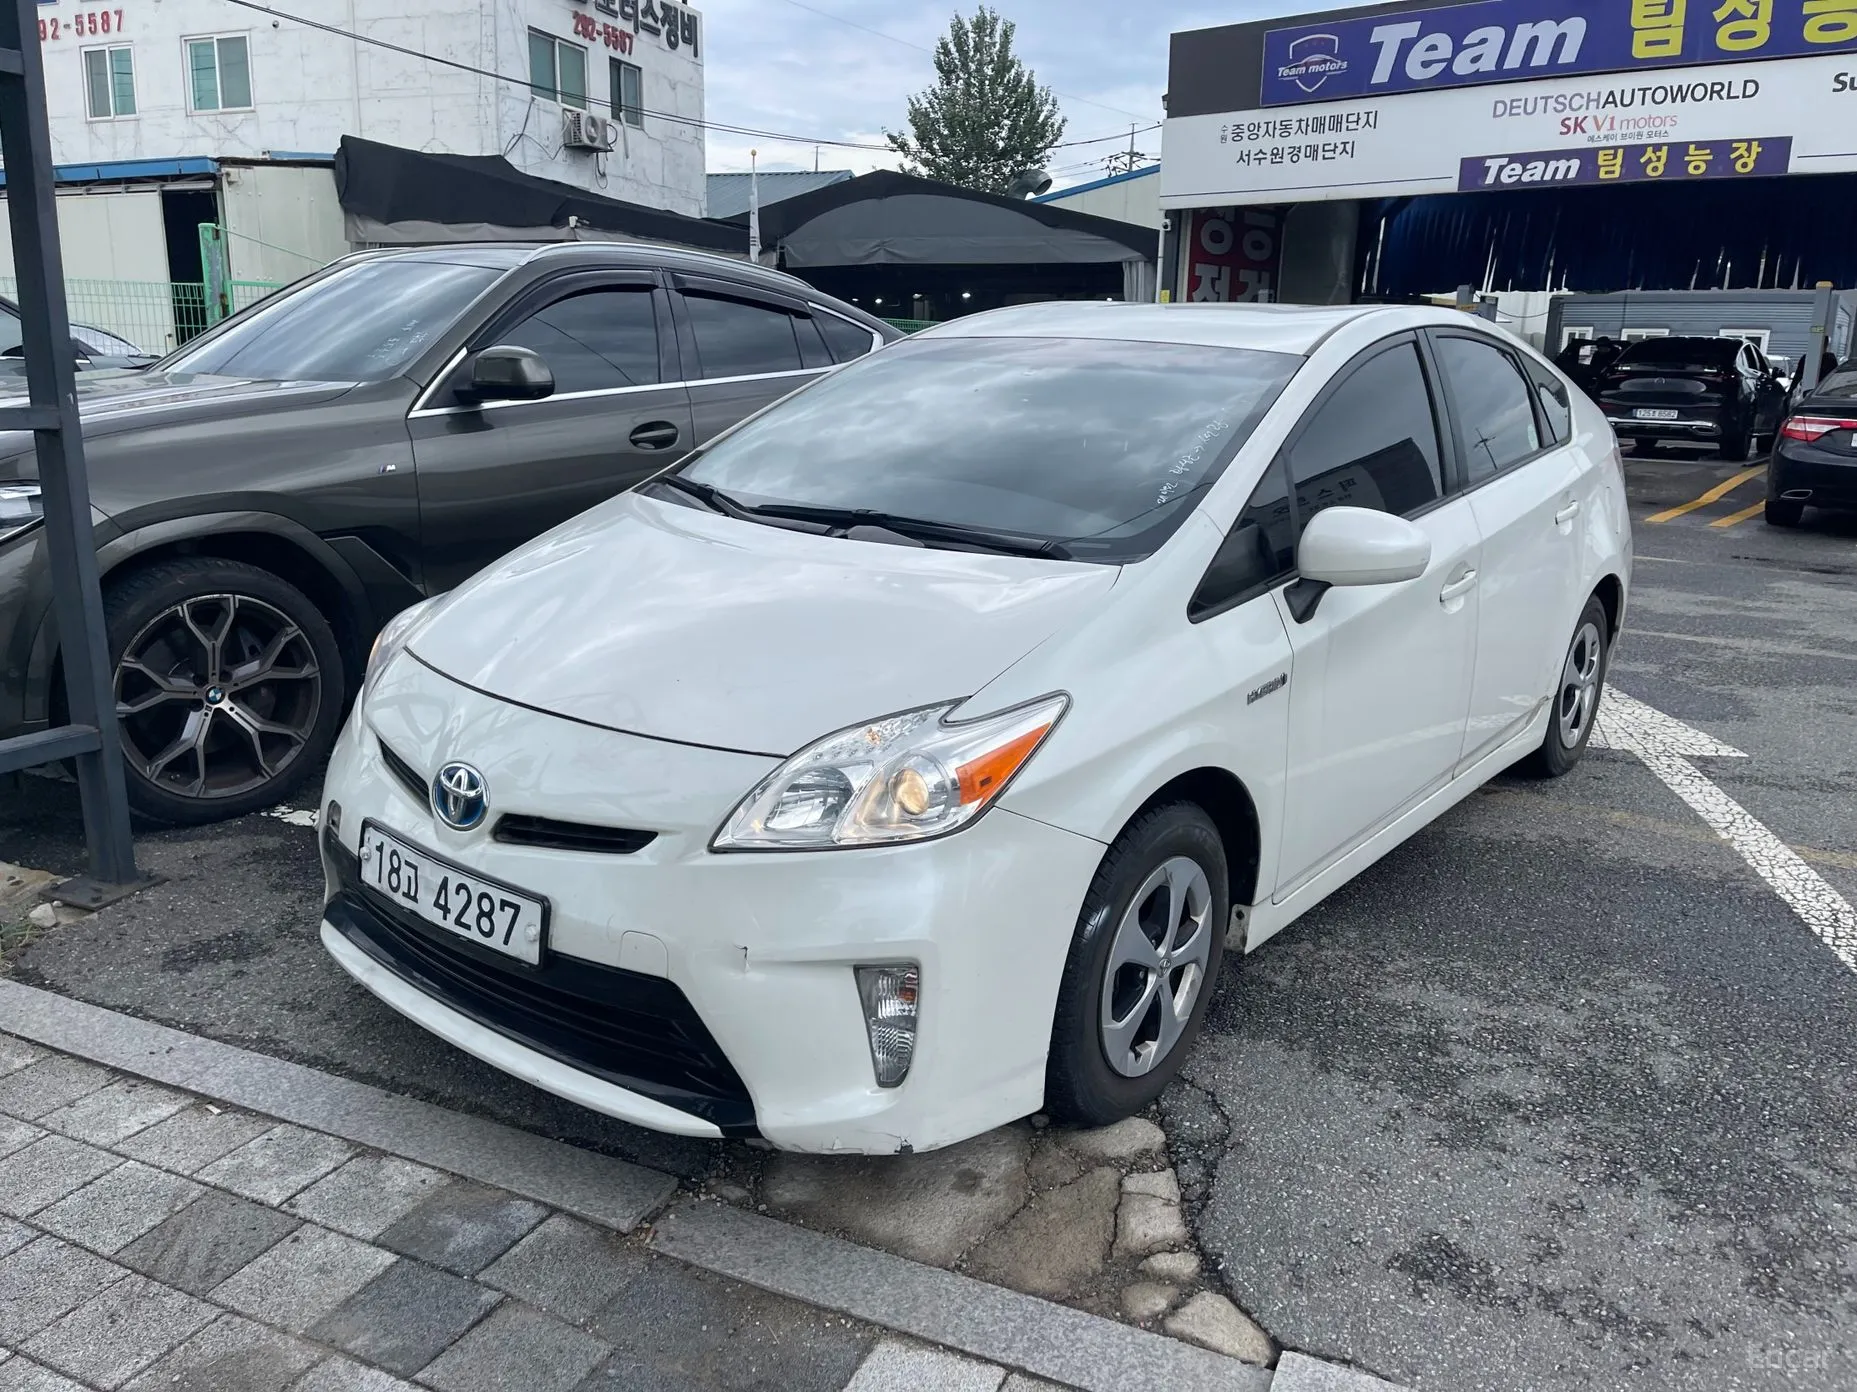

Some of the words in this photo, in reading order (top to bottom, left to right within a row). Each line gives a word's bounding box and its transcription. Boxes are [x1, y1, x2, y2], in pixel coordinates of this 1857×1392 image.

[573, 10, 634, 56] 292-5587
[1369, 16, 1587, 84] Team
[1278, 65, 1306, 77] Team
[1308, 61, 1348, 74] motors
[1492, 79, 1761, 118] DEUTSCHAUTOWORLD
[1231, 110, 1379, 143] 중앙자동차매매단지
[1559, 115, 1588, 136] SK
[1592, 113, 1617, 132] V1
[1619, 114, 1679, 131] motors
[1587, 134, 1618, 143] 에스케이
[1620, 131, 1644, 141] 브이원
[1646, 130, 1670, 140] 모터스
[1236, 140, 1356, 167] 서수원경매단지
[1484, 156, 1581, 186] Team
[433, 876, 521, 946] 4287
